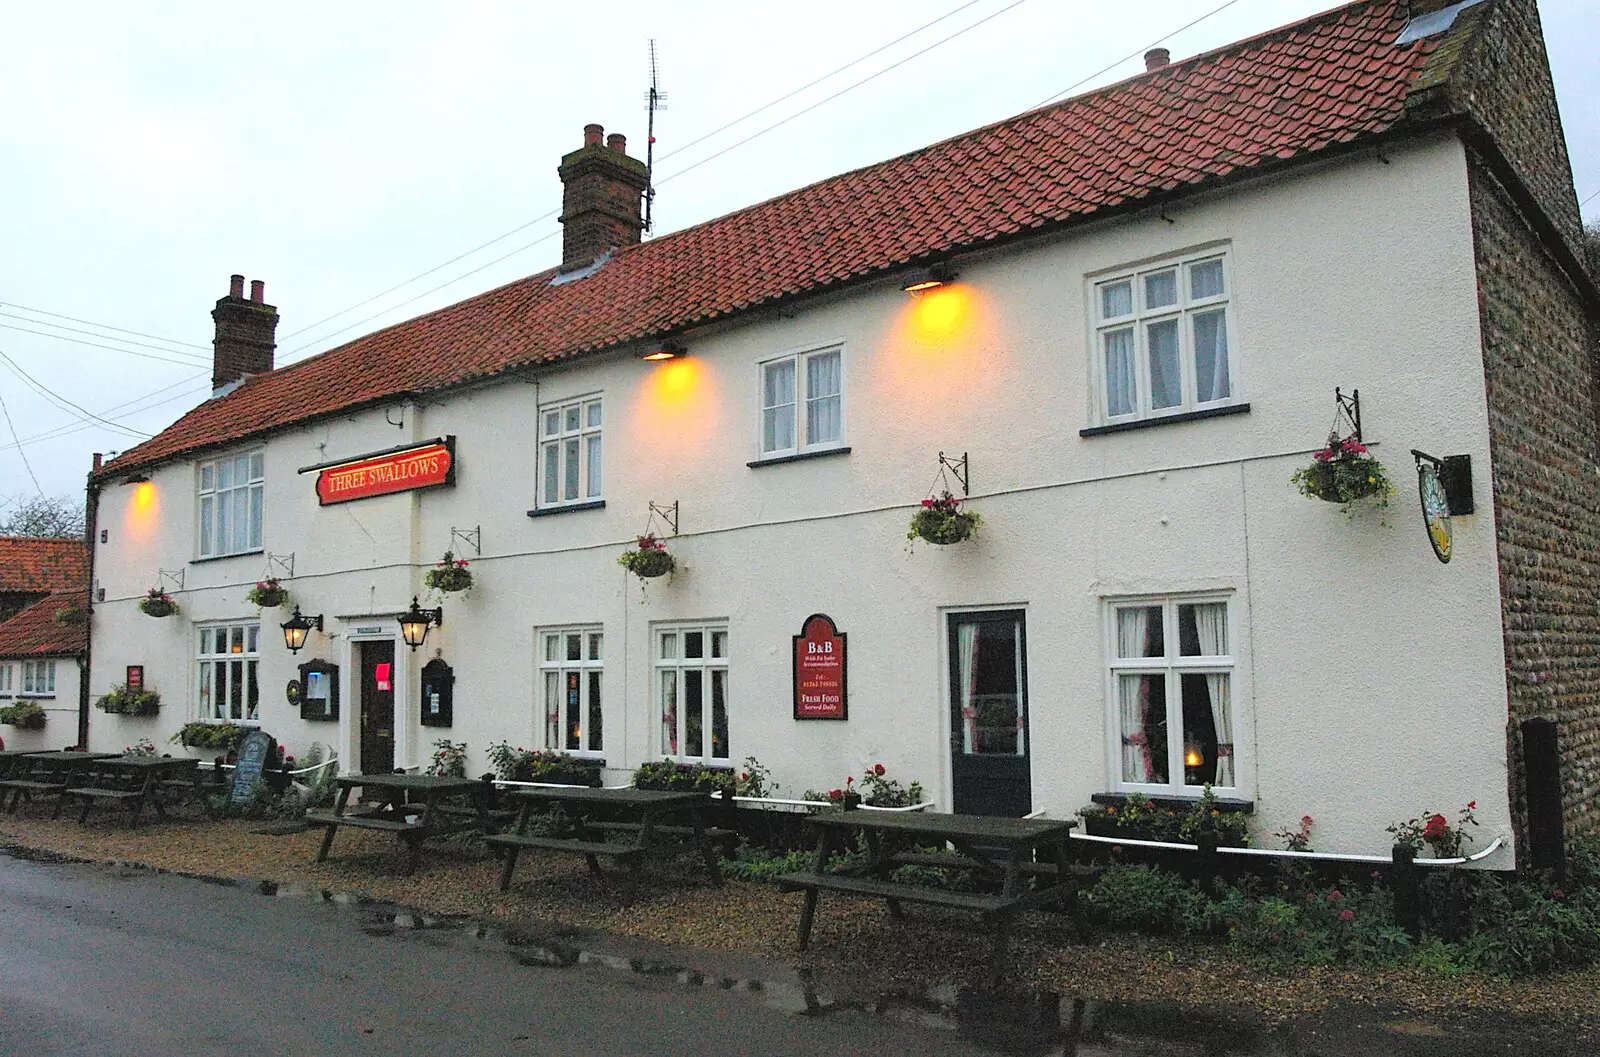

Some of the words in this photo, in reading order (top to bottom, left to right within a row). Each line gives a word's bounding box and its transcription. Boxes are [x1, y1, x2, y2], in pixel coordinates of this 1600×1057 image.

[329, 473, 366, 492] THREE
[369, 457, 438, 485] SWALLOWS
[808, 641, 832, 654] B&B
[802, 694, 821, 702] FRESH
[822, 694, 839, 702] FOOD
[822, 703, 837, 711] Daily
